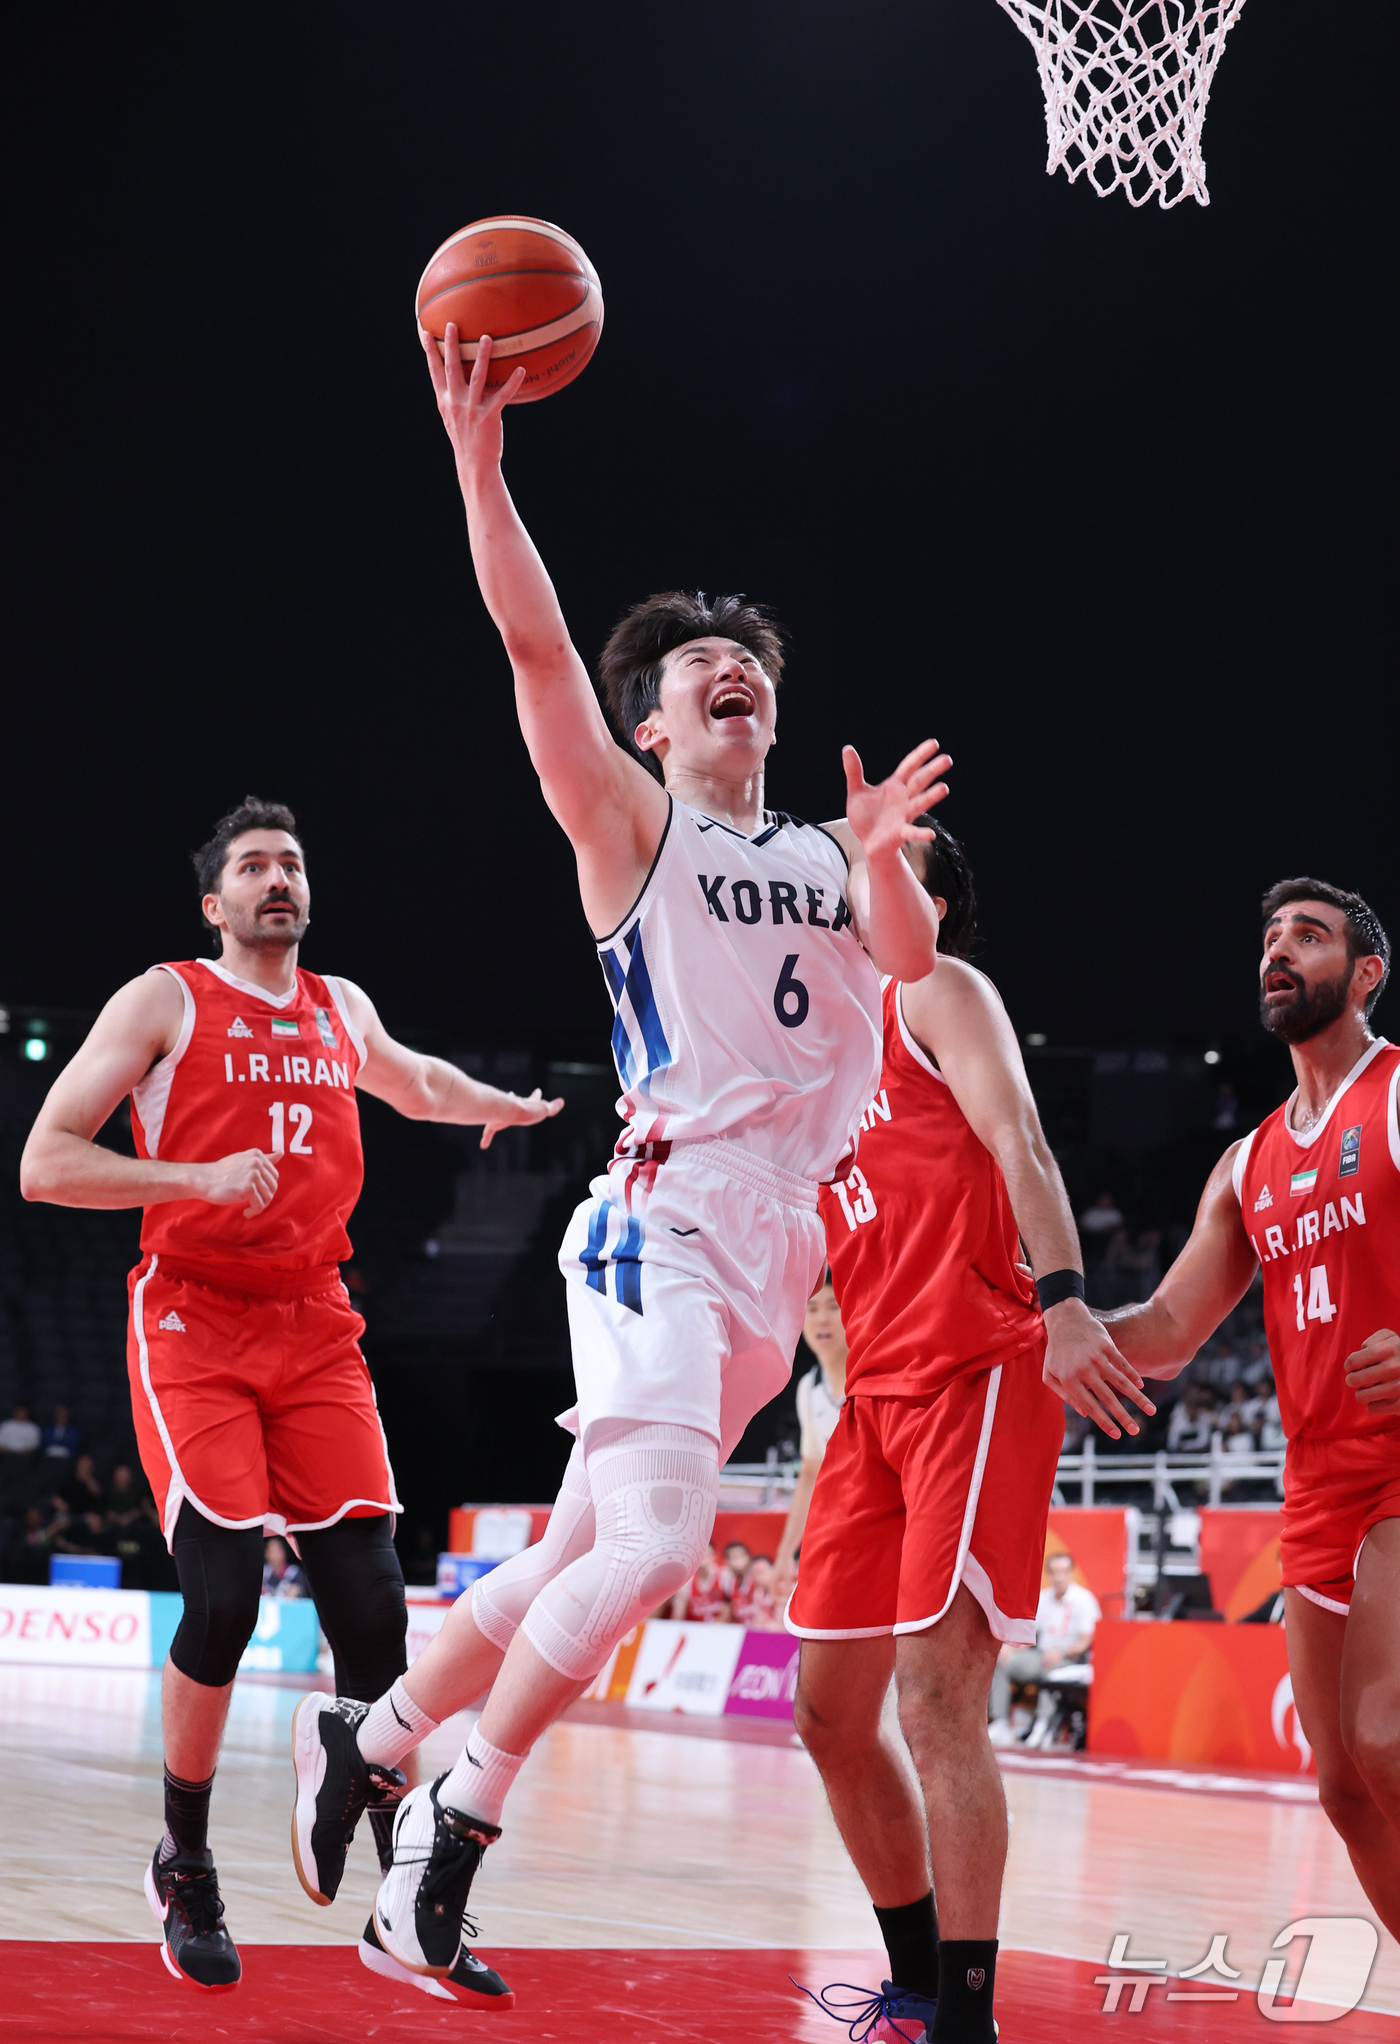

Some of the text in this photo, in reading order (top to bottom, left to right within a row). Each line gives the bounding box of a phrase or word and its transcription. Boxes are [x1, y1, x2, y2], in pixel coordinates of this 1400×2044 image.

[773, 954, 810, 1028] 6
[227, 1027, 255, 1039] PEAK
[268, 1101, 313, 1155] 12
[829, 1164, 878, 1233] 13
[1254, 1194, 1274, 1213] PEAK
[1293, 1264, 1338, 1332] 14
[158, 1319, 187, 1333] PEAK
